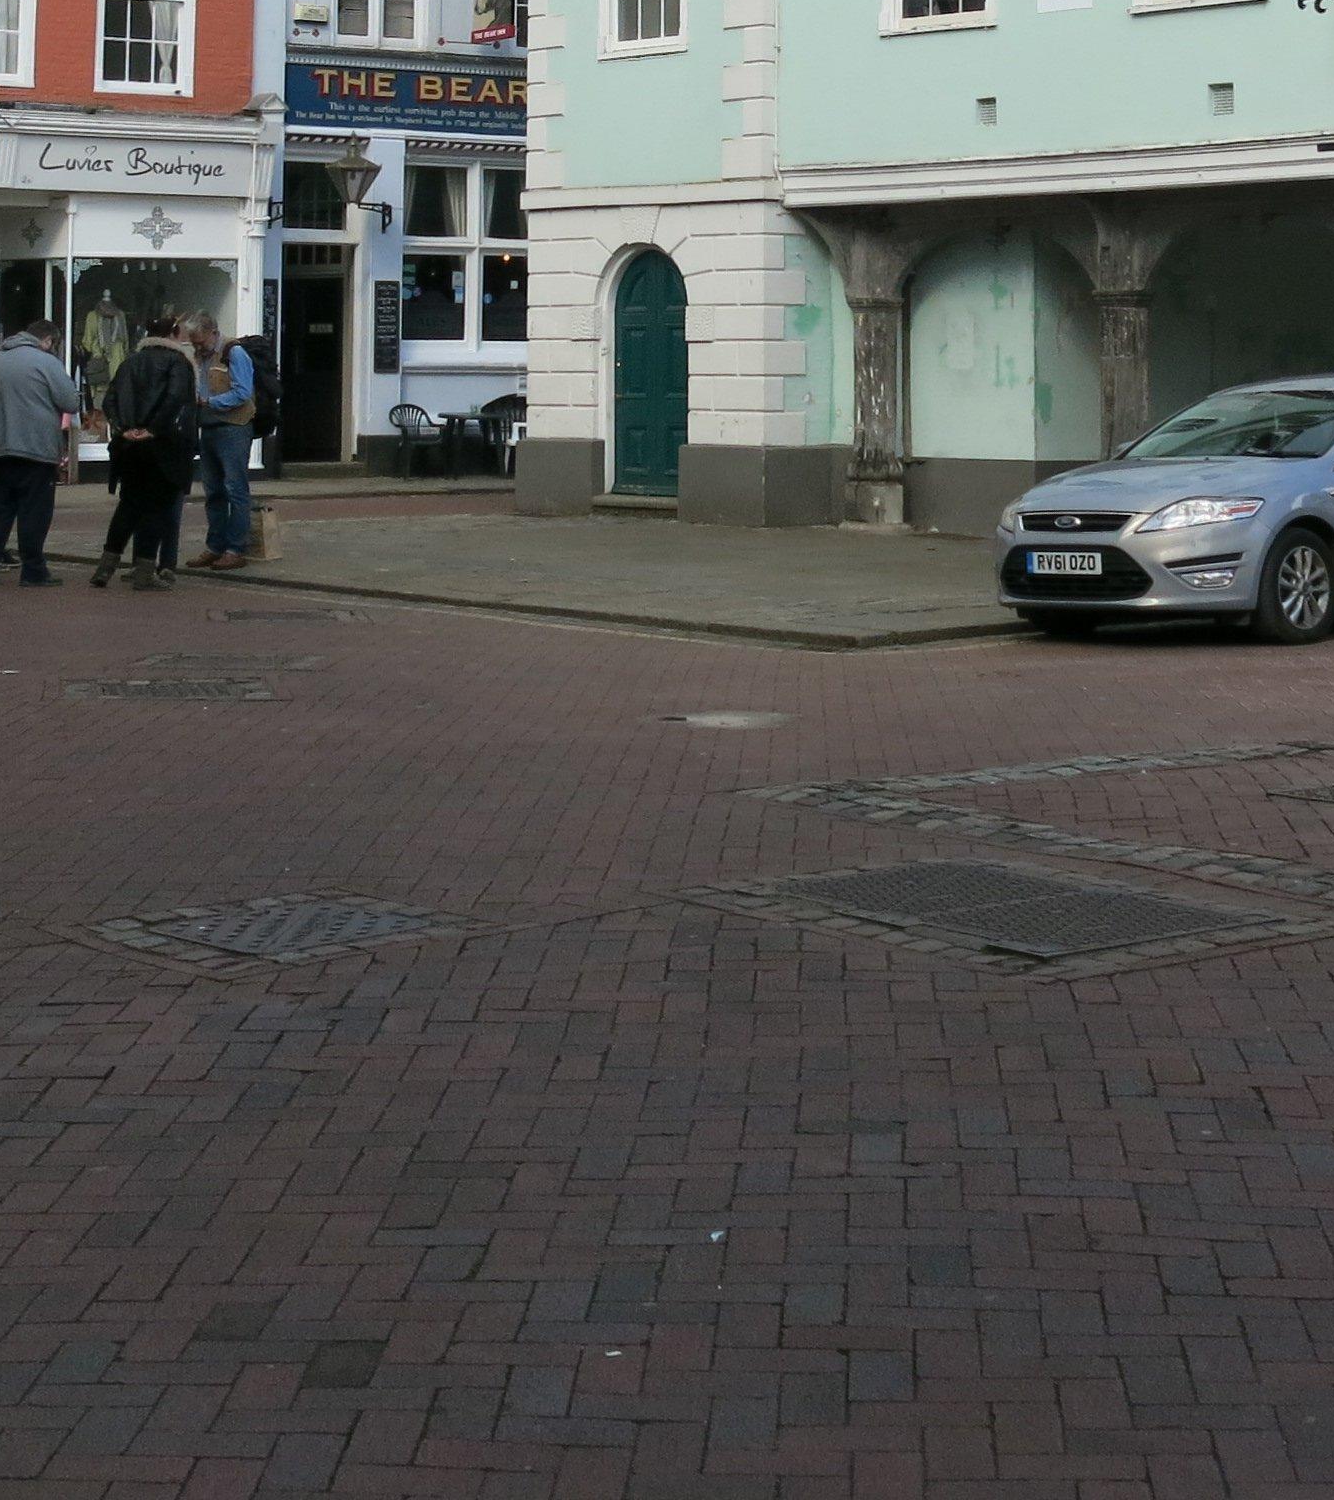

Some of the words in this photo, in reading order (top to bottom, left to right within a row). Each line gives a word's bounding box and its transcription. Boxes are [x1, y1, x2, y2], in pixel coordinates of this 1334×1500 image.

[314, 69, 397, 98] THE
[418, 75, 527, 104] BEAR
[39, 143, 114, 172] Luvies
[126, 147, 226, 185] Boutique
